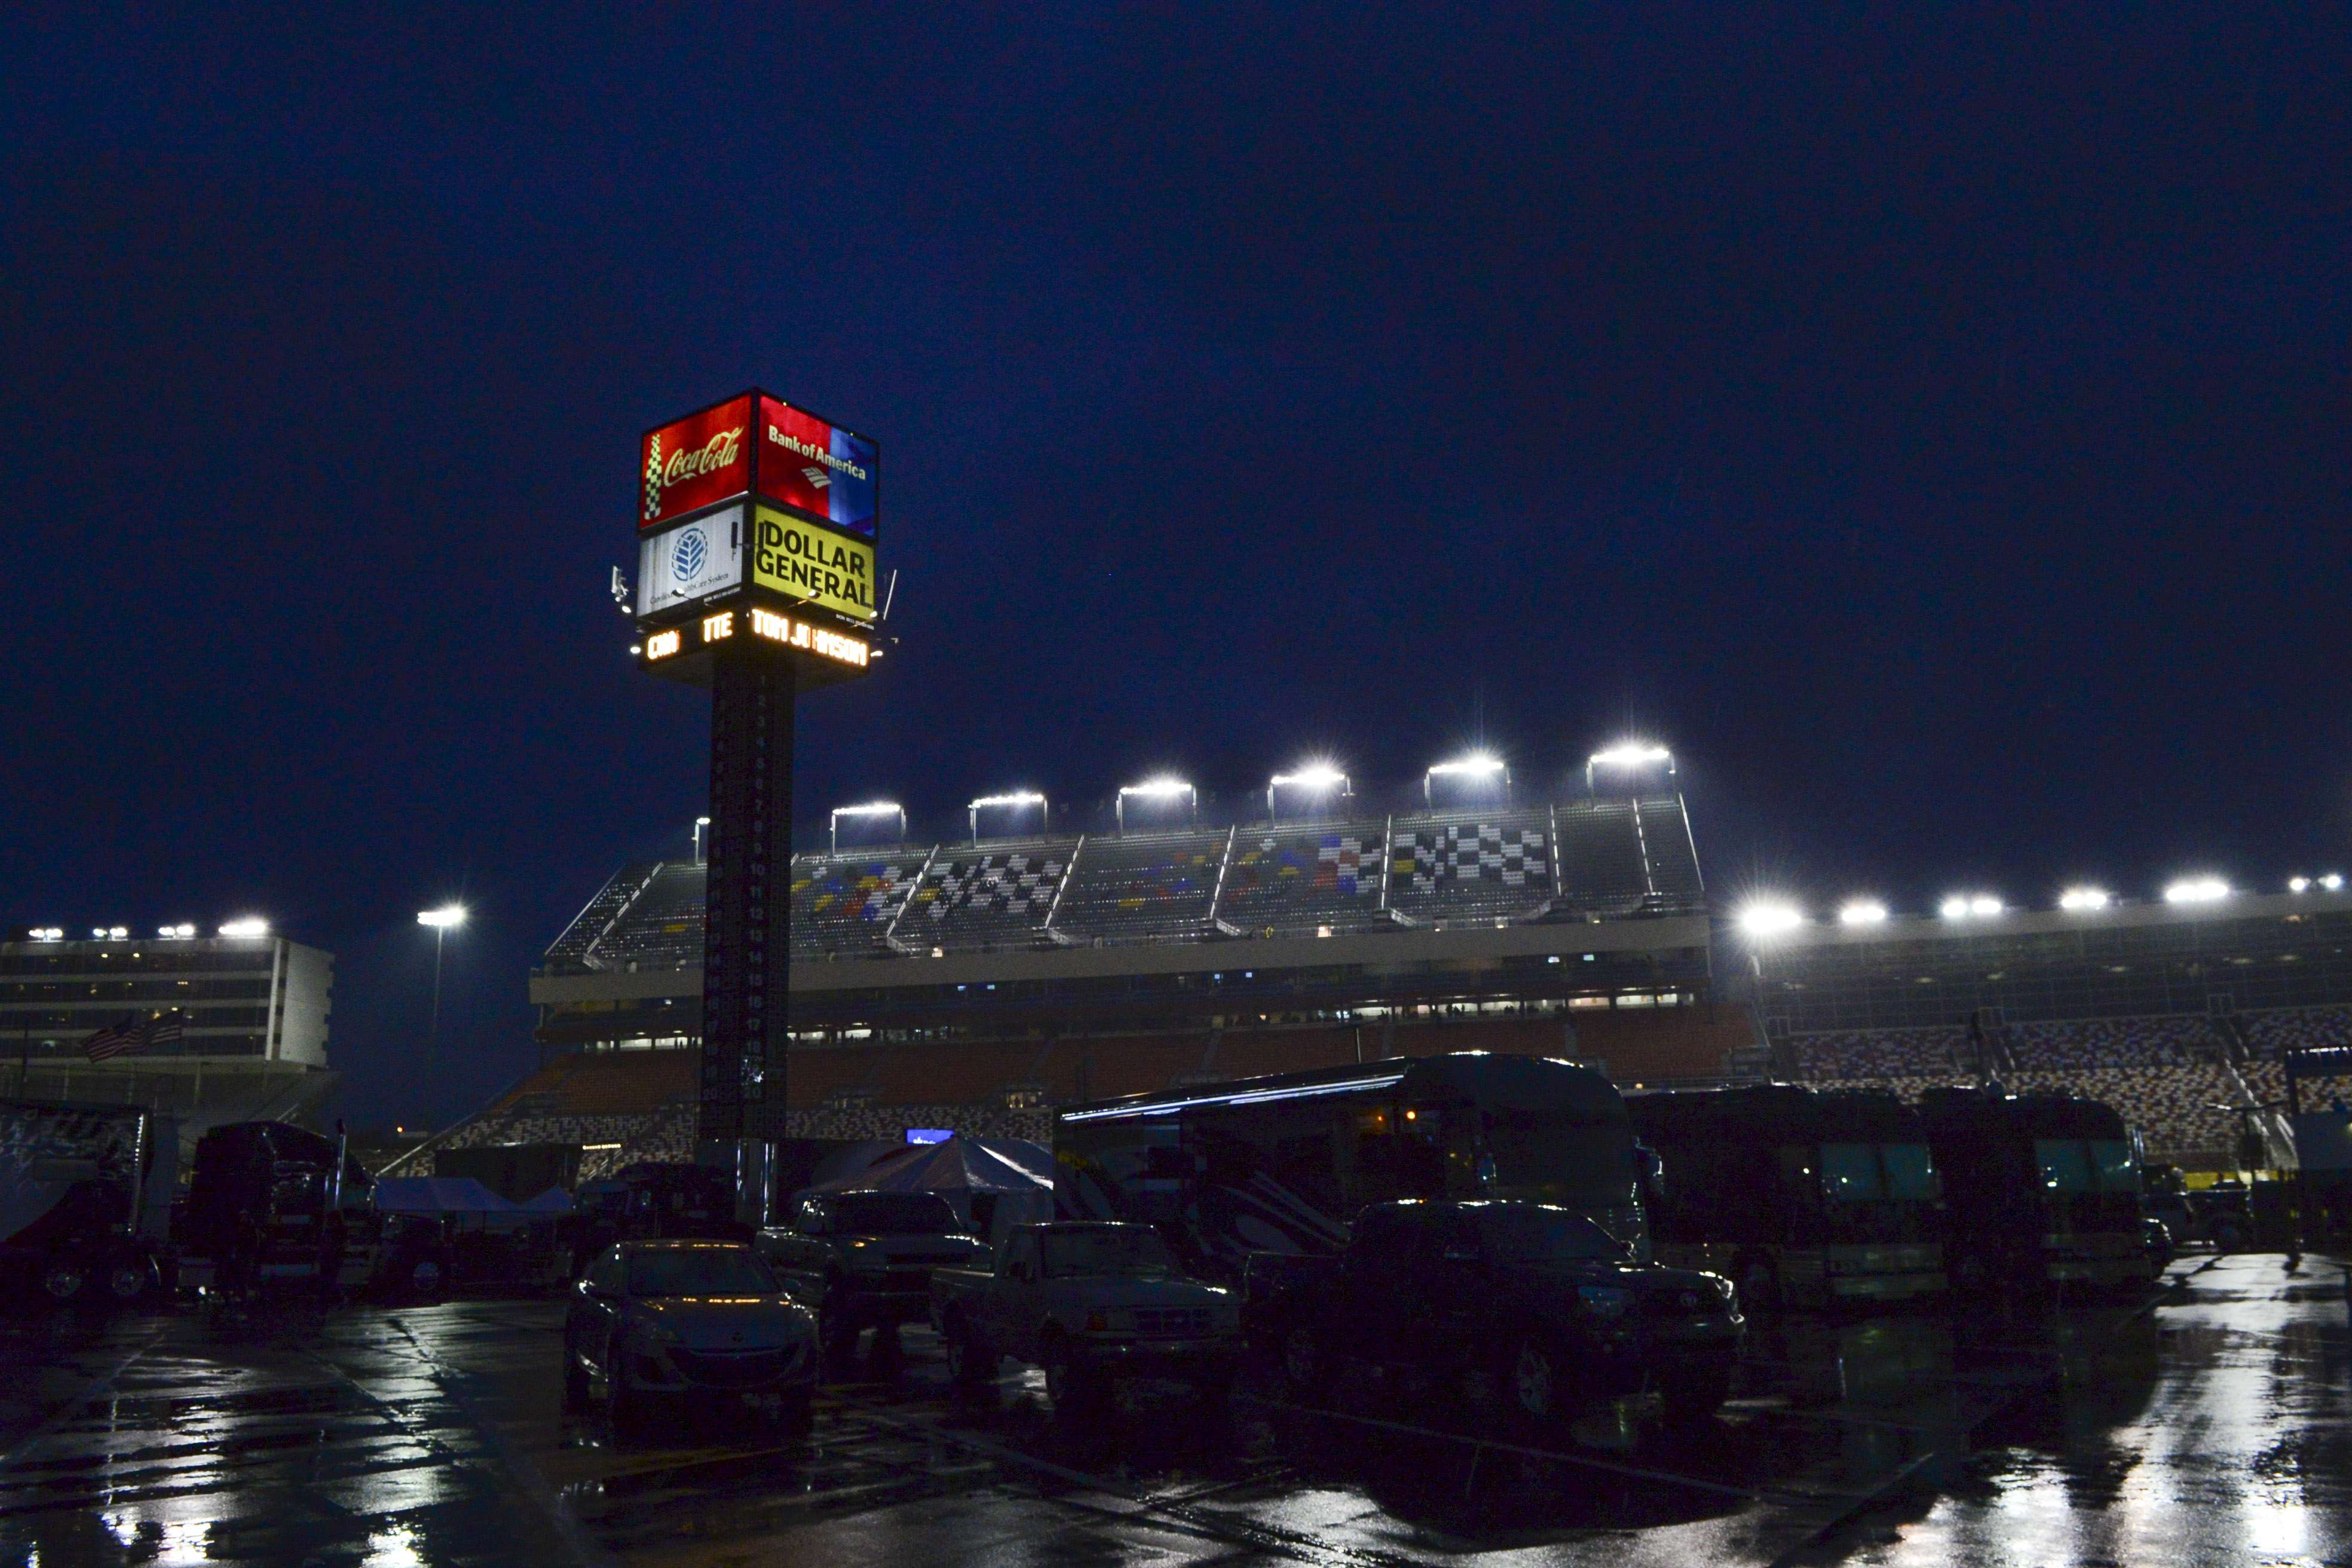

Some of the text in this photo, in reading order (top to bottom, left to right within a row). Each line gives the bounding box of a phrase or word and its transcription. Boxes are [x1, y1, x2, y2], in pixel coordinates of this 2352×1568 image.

[664, 426, 744, 487] Coca-Cola
[769, 425, 866, 480] Bank of America
[756, 549, 872, 608] GENERAL
[764, 520, 865, 579] DOLLAR
